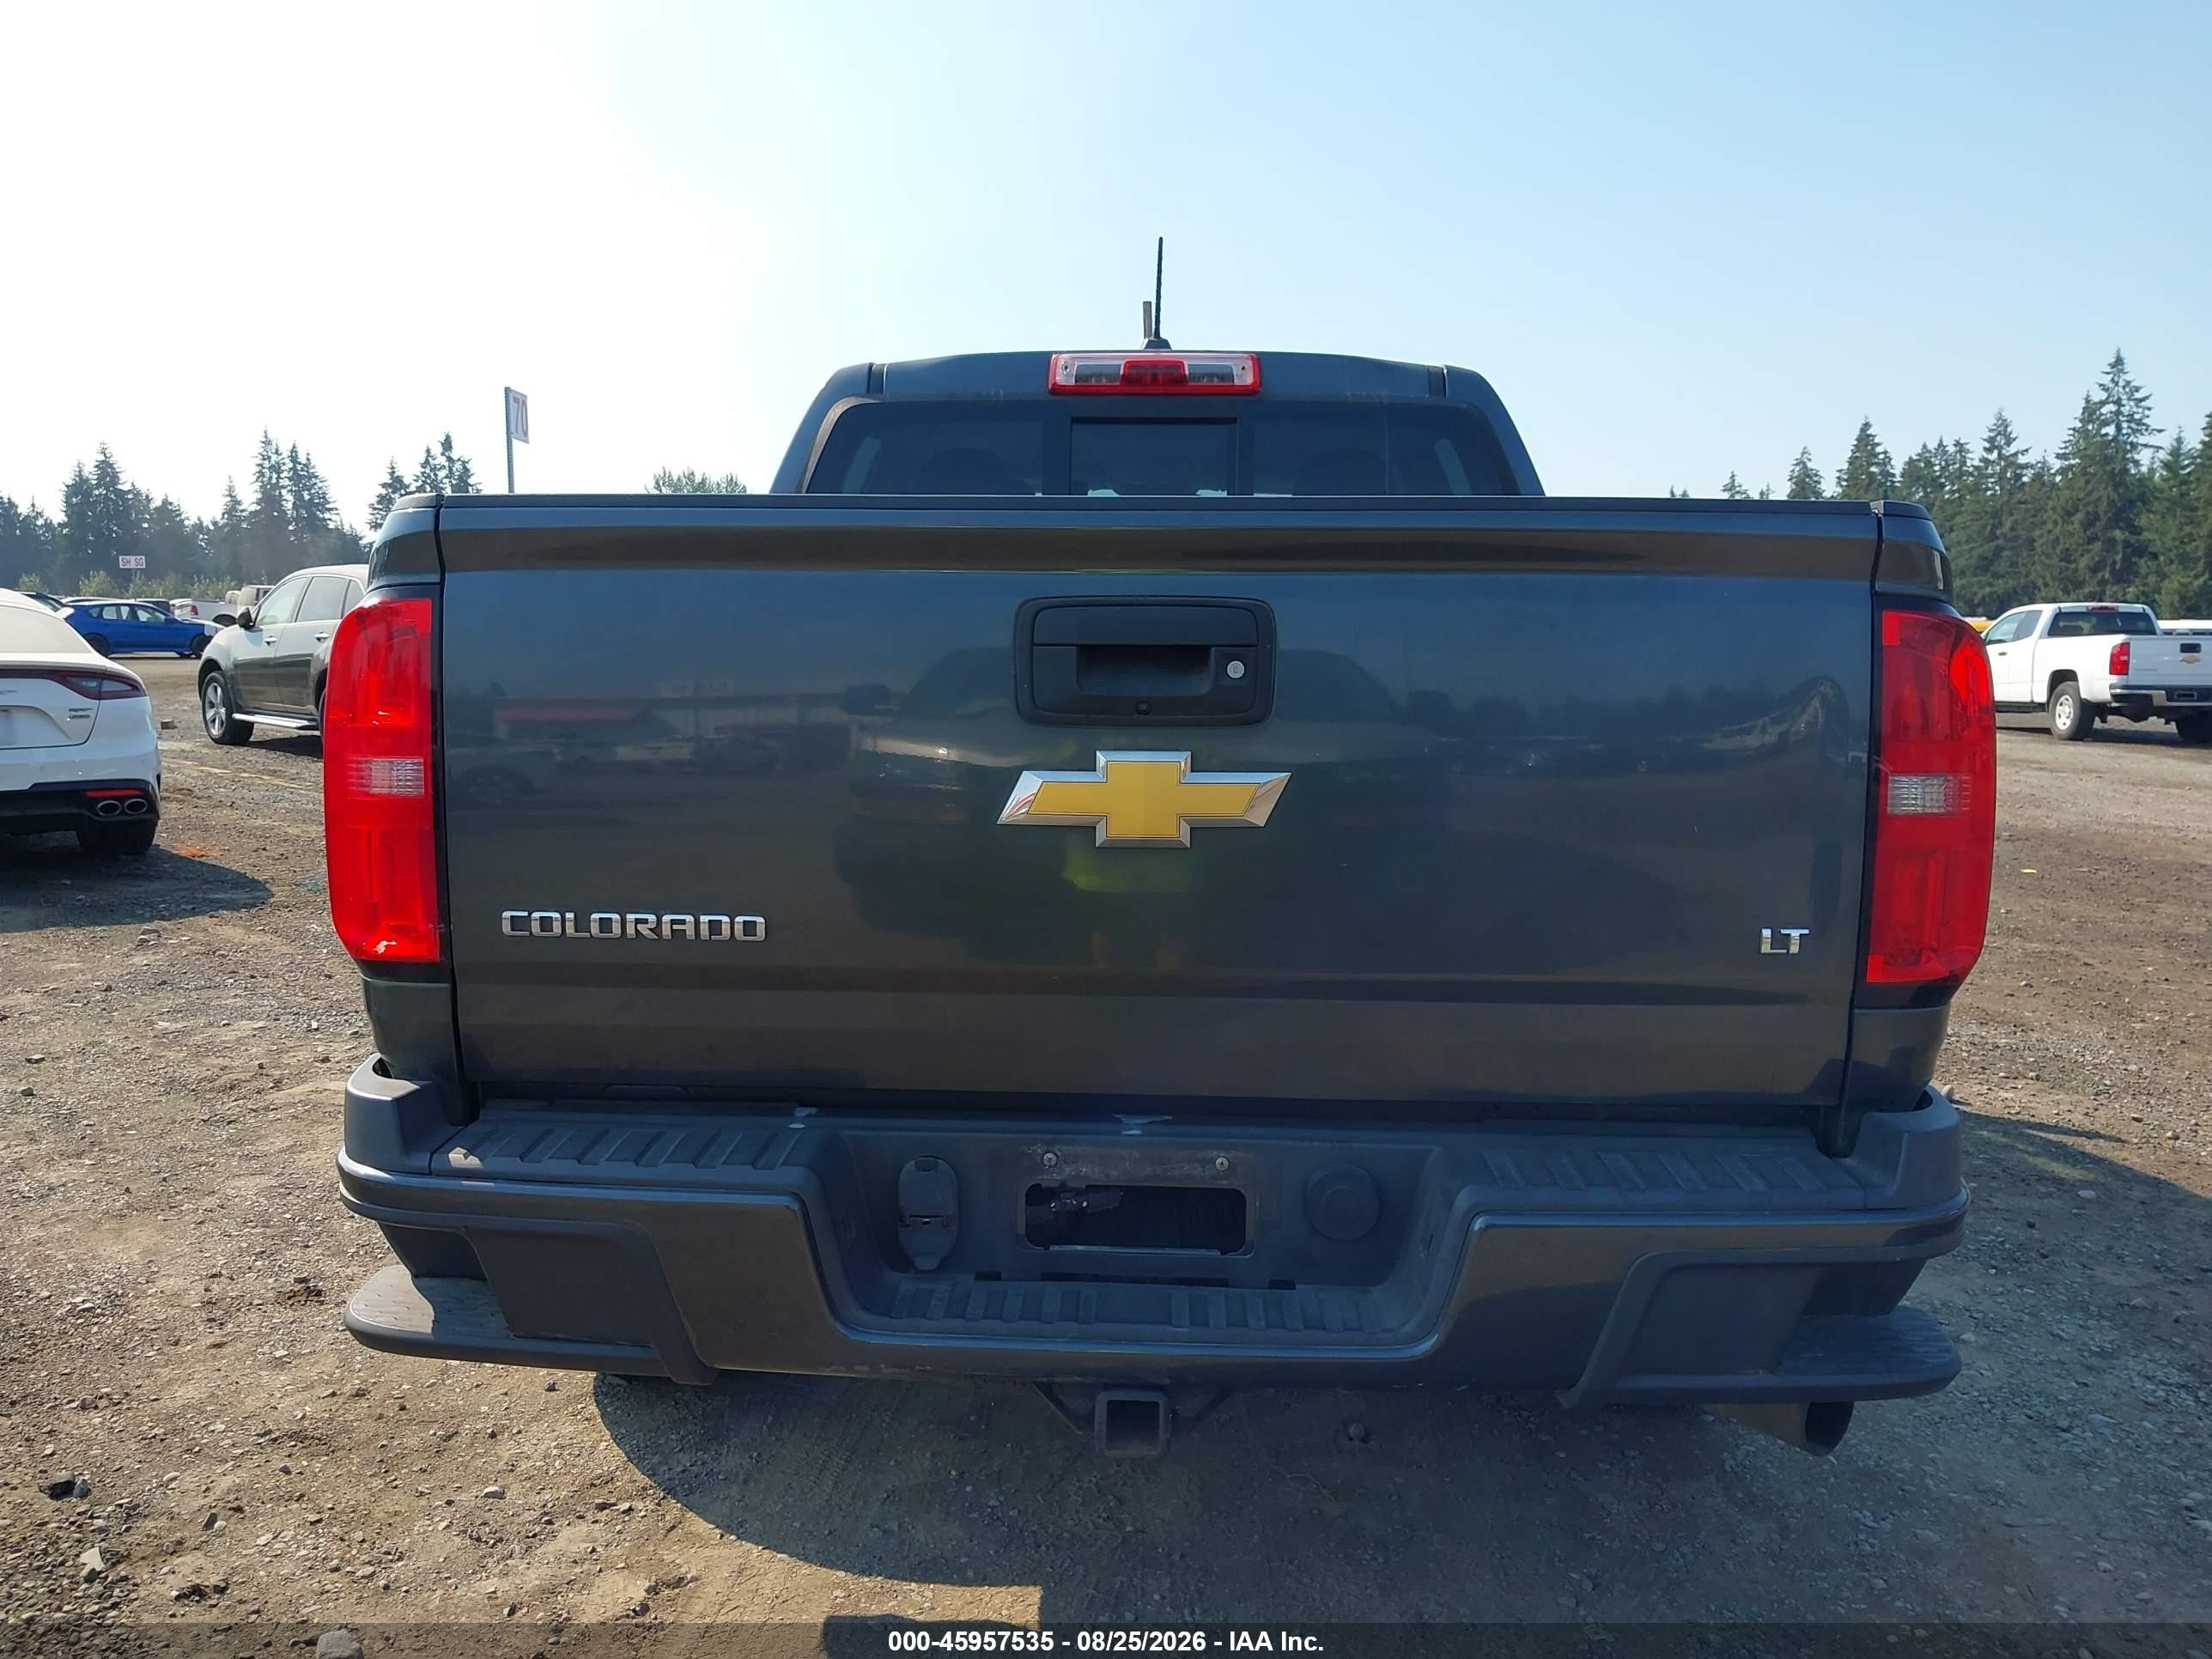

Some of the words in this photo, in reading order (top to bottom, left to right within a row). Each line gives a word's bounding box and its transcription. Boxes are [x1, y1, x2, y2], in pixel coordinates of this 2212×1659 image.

[513, 395, 528, 437] 70
[121, 556, 131, 567] SH
[501, 909, 767, 942] COLORADO
[1760, 927, 1810, 954] LT
